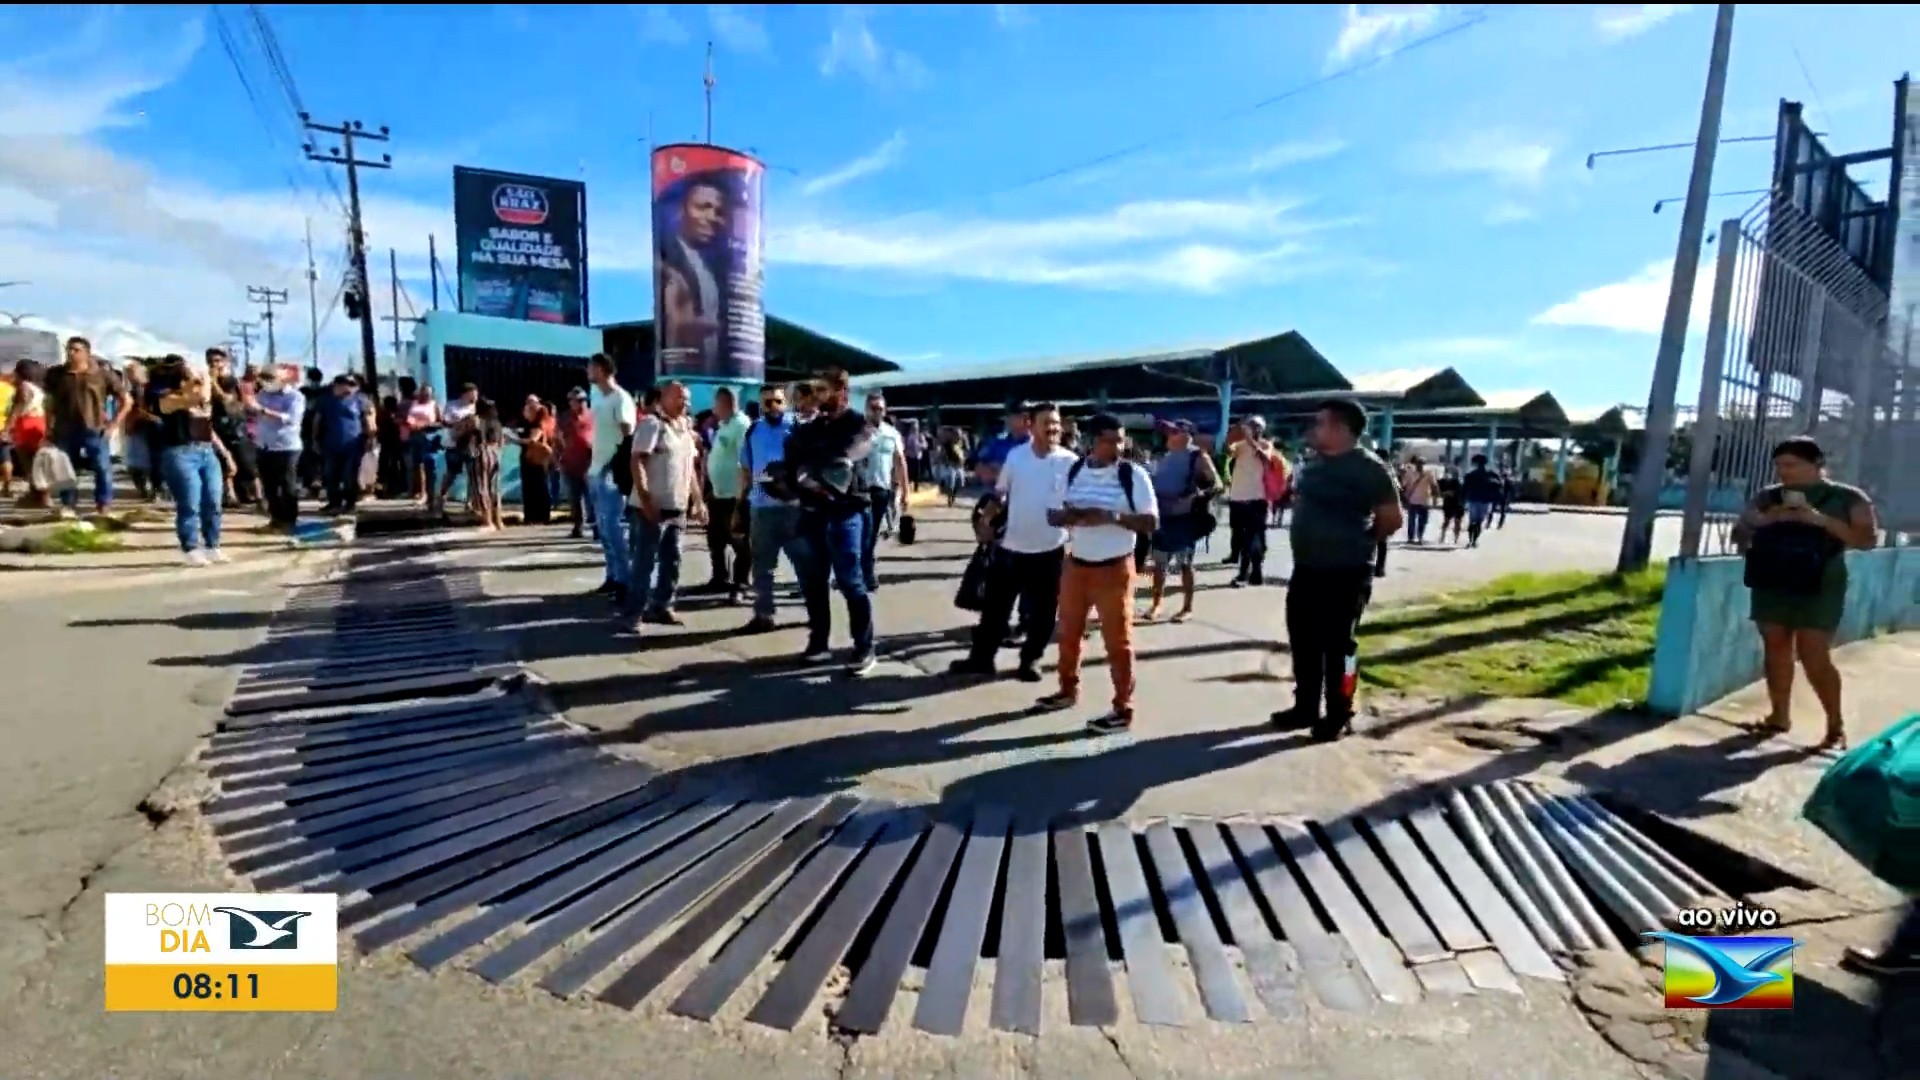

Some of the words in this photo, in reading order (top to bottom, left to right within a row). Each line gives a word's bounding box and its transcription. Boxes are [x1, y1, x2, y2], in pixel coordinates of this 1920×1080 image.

[488, 226, 540, 244] SABOR
[543, 232, 554, 245] E
[480, 237, 563, 258] QUALIDADE
[471, 251, 494, 264] NA
[496, 252, 528, 266] SUA
[530, 256, 573, 270] MESA
